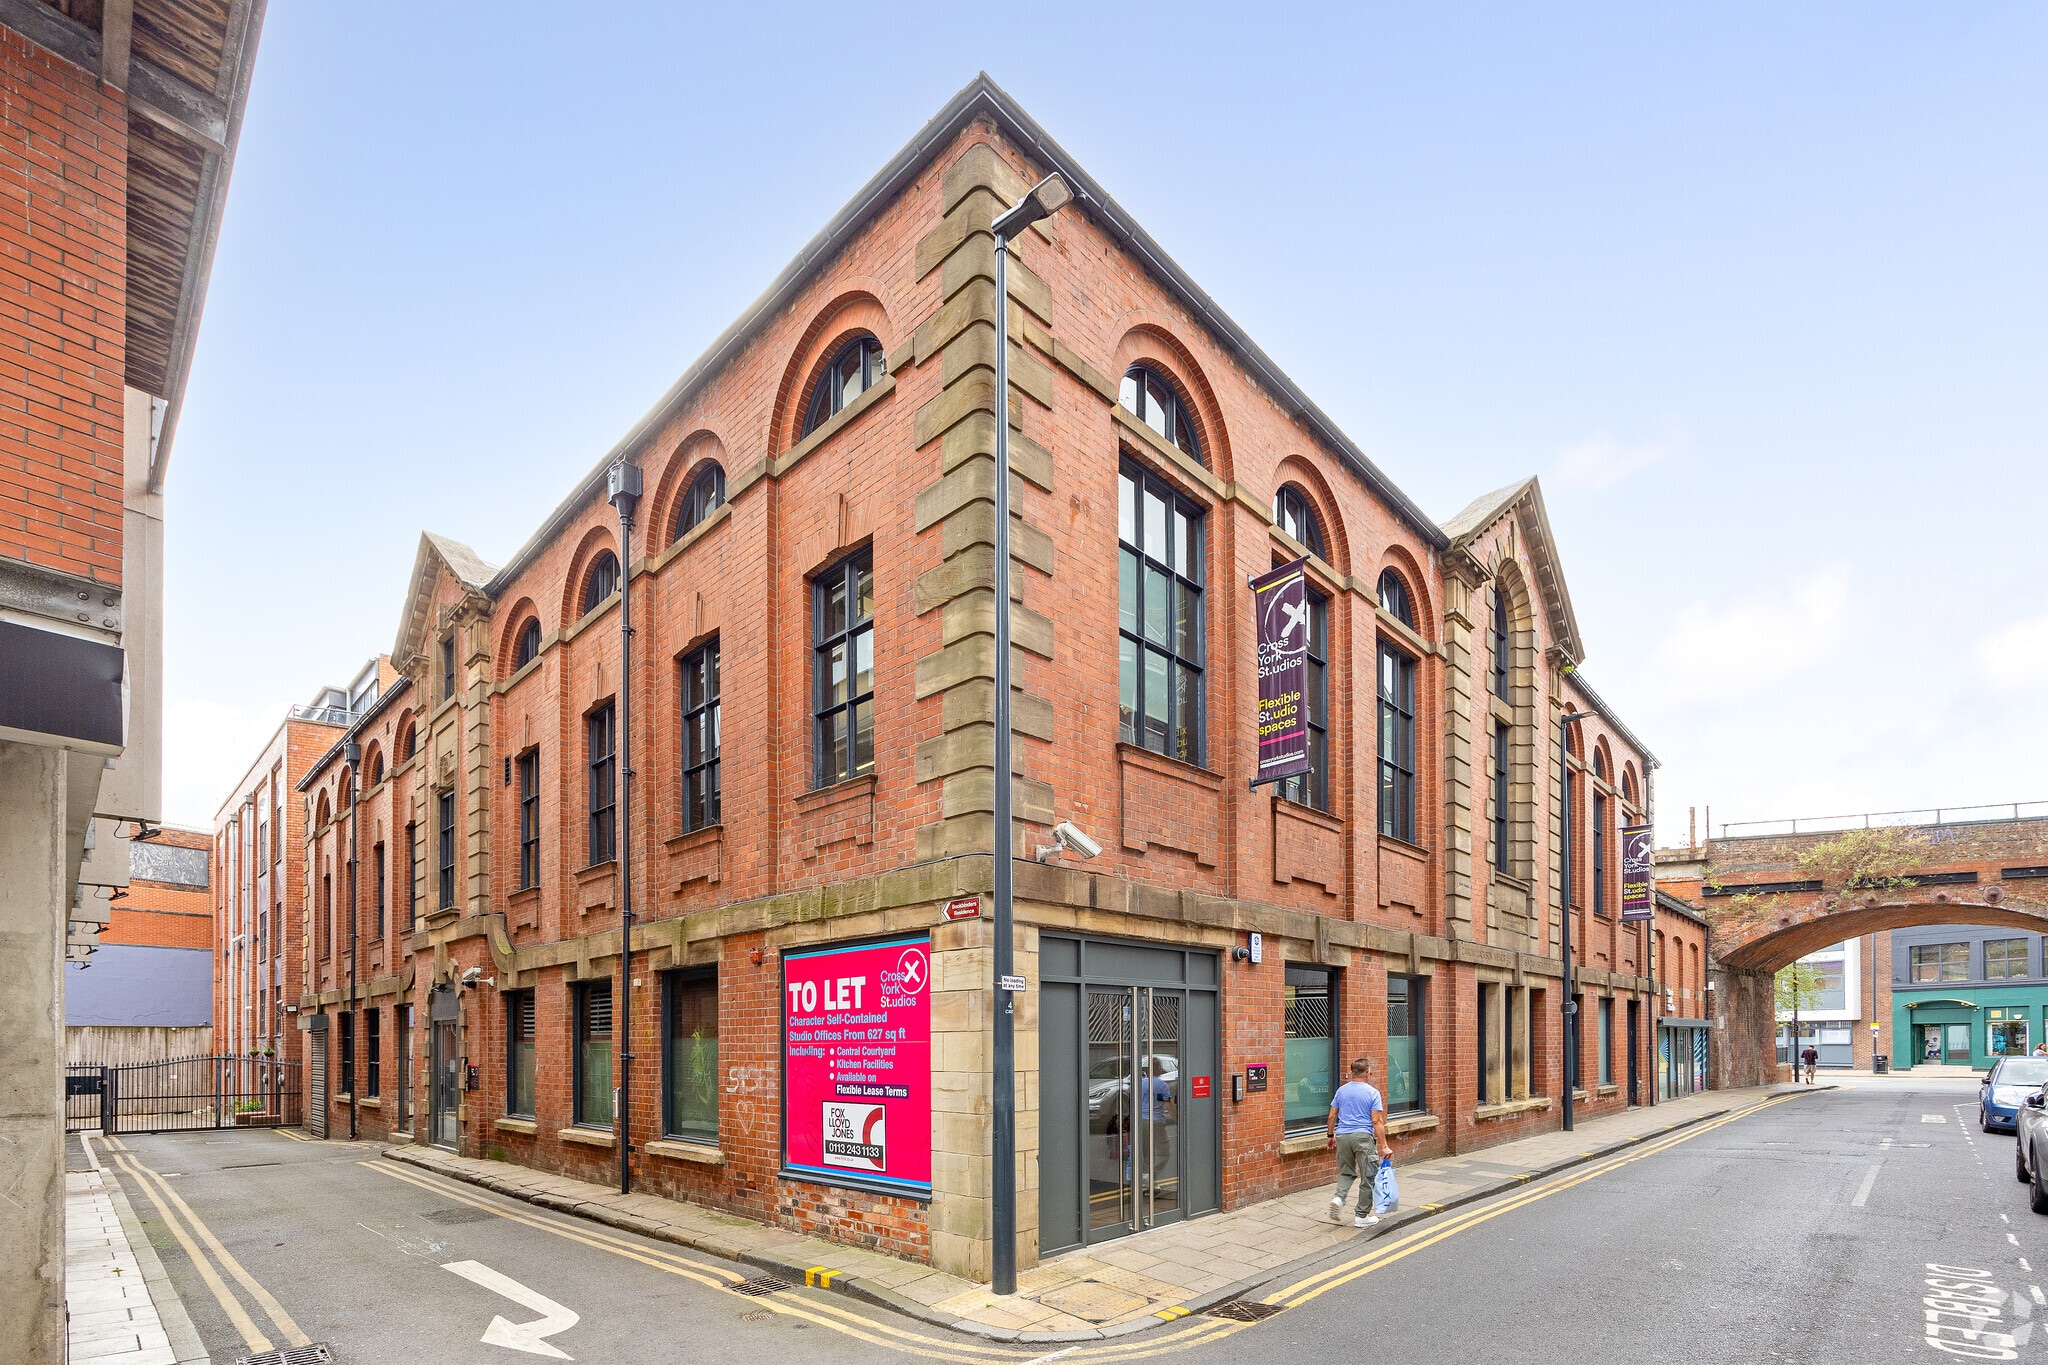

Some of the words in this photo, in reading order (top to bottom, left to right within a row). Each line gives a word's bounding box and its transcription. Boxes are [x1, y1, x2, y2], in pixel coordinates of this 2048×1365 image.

[1258, 636, 1288, 654] Cross
[1258, 652, 1282, 666] York
[1258, 656, 1302, 678] St.udios
[1259, 690, 1300, 711] Flexible
[1259, 704, 1298, 723] St.udio
[1259, 717, 1296, 736] spaces
[880, 970, 906, 982] Cross
[789, 981, 817, 1012] TO
[824, 976, 866, 1010] LET
[880, 983, 900, 994] York
[880, 994, 916, 1008] St.udios
[789, 1014, 824, 1026] Character
[827, 1012, 887, 1025] Self-Contained
[789, 1030, 812, 1041] Studio
[814, 1030, 842, 1040] Offices
[844, 1029, 865, 1040] From
[868, 1029, 882, 1039] 627
[885, 1030, 896, 1042] sq
[899, 1028, 906, 1039] ft
[789, 1046, 825, 1058] Including:
[836, 1046, 860, 1056] Central
[862, 1046, 896, 1058] Courtyard
[836, 1060, 862, 1069] Kitchen
[863, 1060, 894, 1069] Facilities
[836, 1072, 866, 1082] Available
[836, 1084, 862, 1095] Flexible
[863, 1086, 884, 1096] Lease
[885, 1086, 907, 1097] Terms
[831, 1108, 845, 1118] FOX
[828, 1118, 850, 1128] LLOYD
[832, 1128, 854, 1139] JONES
[829, 1142, 846, 1154] 0113
[847, 1144, 861, 1155] 243
[862, 1145, 879, 1158] 1133
[1923, 1264, 2018, 1360] DISABLED
